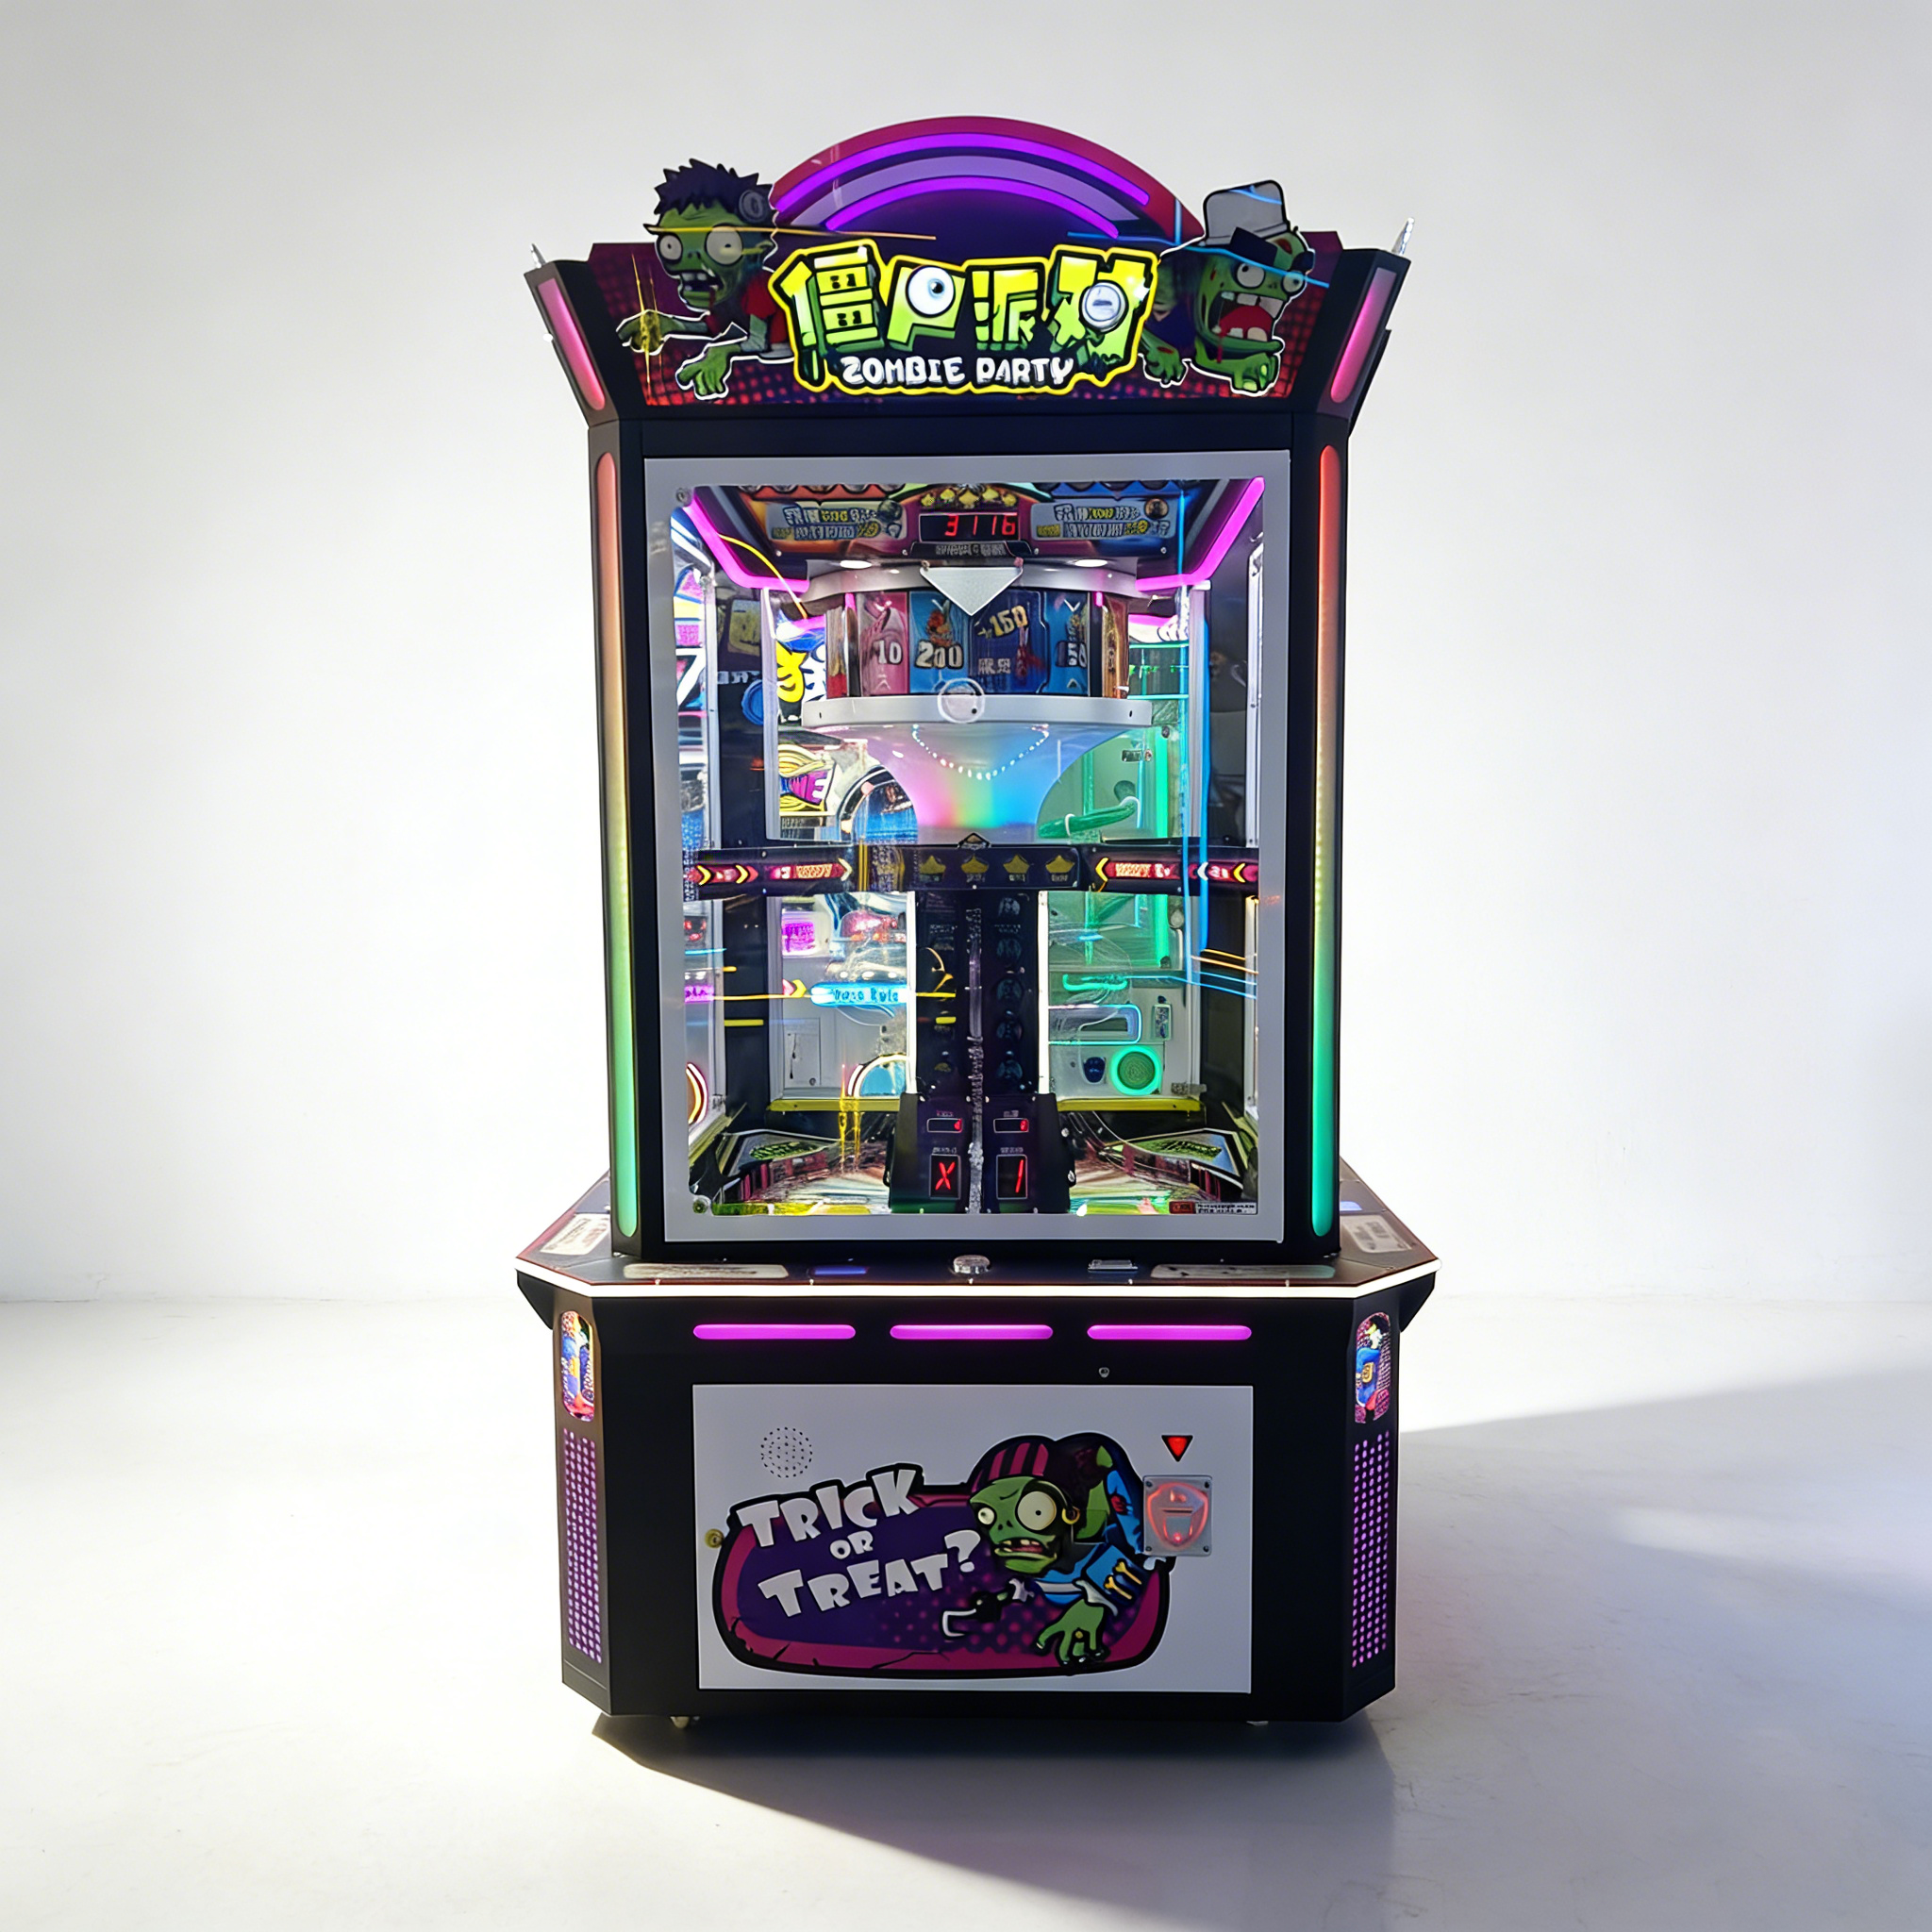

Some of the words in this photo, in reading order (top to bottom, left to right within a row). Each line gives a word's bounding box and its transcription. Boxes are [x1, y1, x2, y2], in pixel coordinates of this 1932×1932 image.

[842, 356, 966, 385] ZOMBIE
[975, 356, 1074, 385] PARTY
[944, 513, 1016, 537] 3116
[916, 641, 963, 668] 200
[737, 1469, 920, 1547] TRICK
[830, 1530, 874, 1559] OR
[758, 1529, 981, 1618] TREAT?
